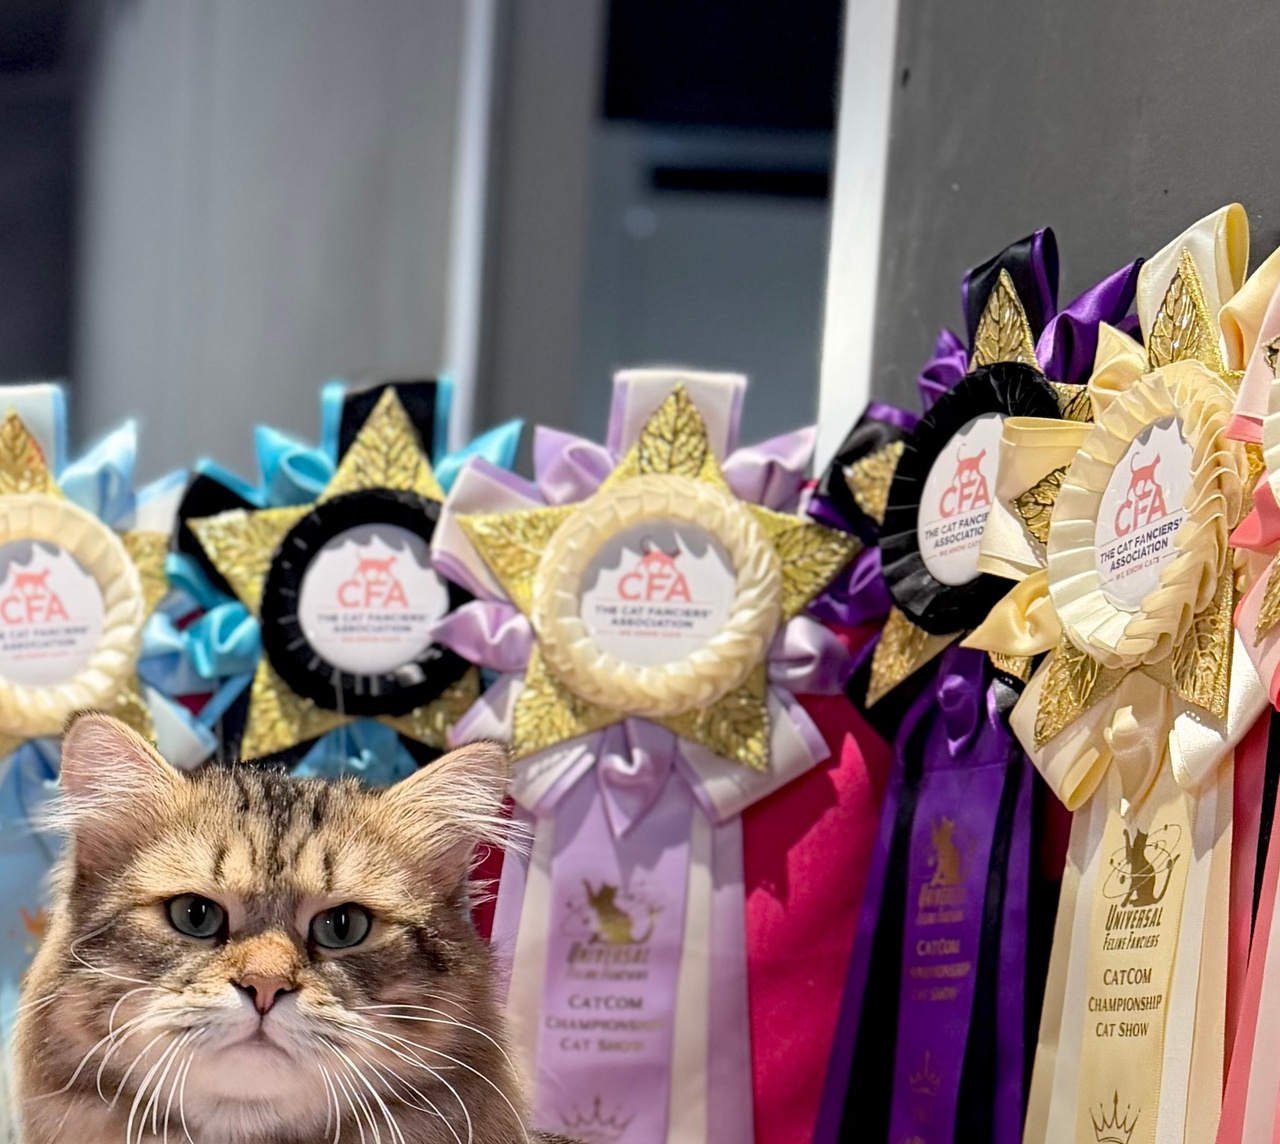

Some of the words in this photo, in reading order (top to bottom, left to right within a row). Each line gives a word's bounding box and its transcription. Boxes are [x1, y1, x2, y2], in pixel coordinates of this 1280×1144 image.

[939, 475, 991, 518] CFA
[1114, 484, 1168, 538] CFA
[925, 526, 939, 540] THE
[941, 521, 957, 535] CAT
[933, 526, 985, 549] ASSOCIATIO
[1100, 547, 1116, 564] THE
[1117, 538, 1134, 556] CAT
[1110, 537, 1169, 573] ASSOCIATION
[337, 579, 409, 608] CFA
[618, 572, 692, 603] CFA
[0, 594, 70, 624] CFA
[595, 605, 617, 615] THE
[621, 606, 644, 616] CAT
[610, 618, 694, 629] ASSOCIATION
[1105, 904, 1163, 931] UNIVERSAL
[1103, 932, 1127, 951] FELINE
[1126, 931, 1160, 949] FANCIERS
[1088, 994, 1162, 1012] CHAMPIONSHIP
[1096, 1022, 1116, 1037] CAT
[1118, 1021, 1149, 1037] SHOW
